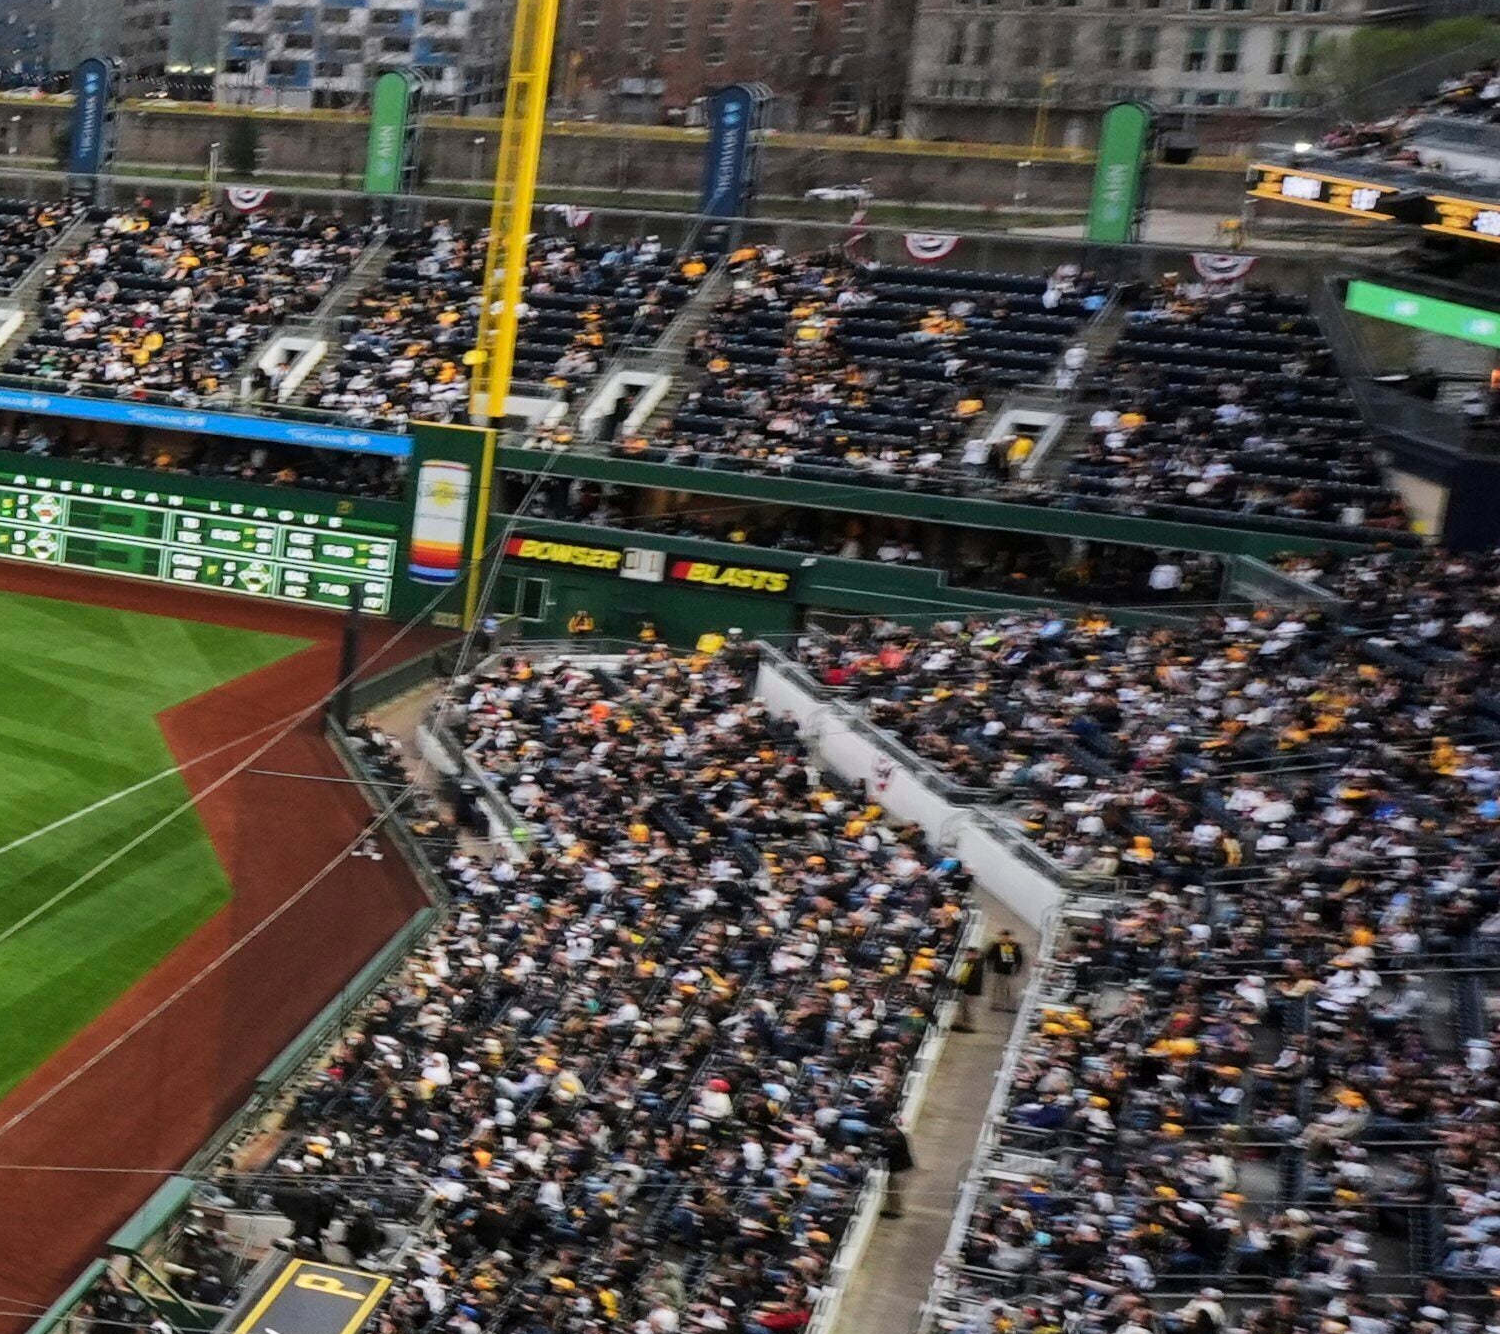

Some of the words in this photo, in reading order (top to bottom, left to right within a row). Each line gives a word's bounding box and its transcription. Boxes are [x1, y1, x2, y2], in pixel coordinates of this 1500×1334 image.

[12, 474, 185, 508] AMERICAN
[208, 500, 344, 529] LEAGUE
[222, 574, 235, 587] 7
[518, 538, 622, 570] BOWSER
[686, 562, 791, 593] BLASTS
[293, 1272, 369, 1301] P
